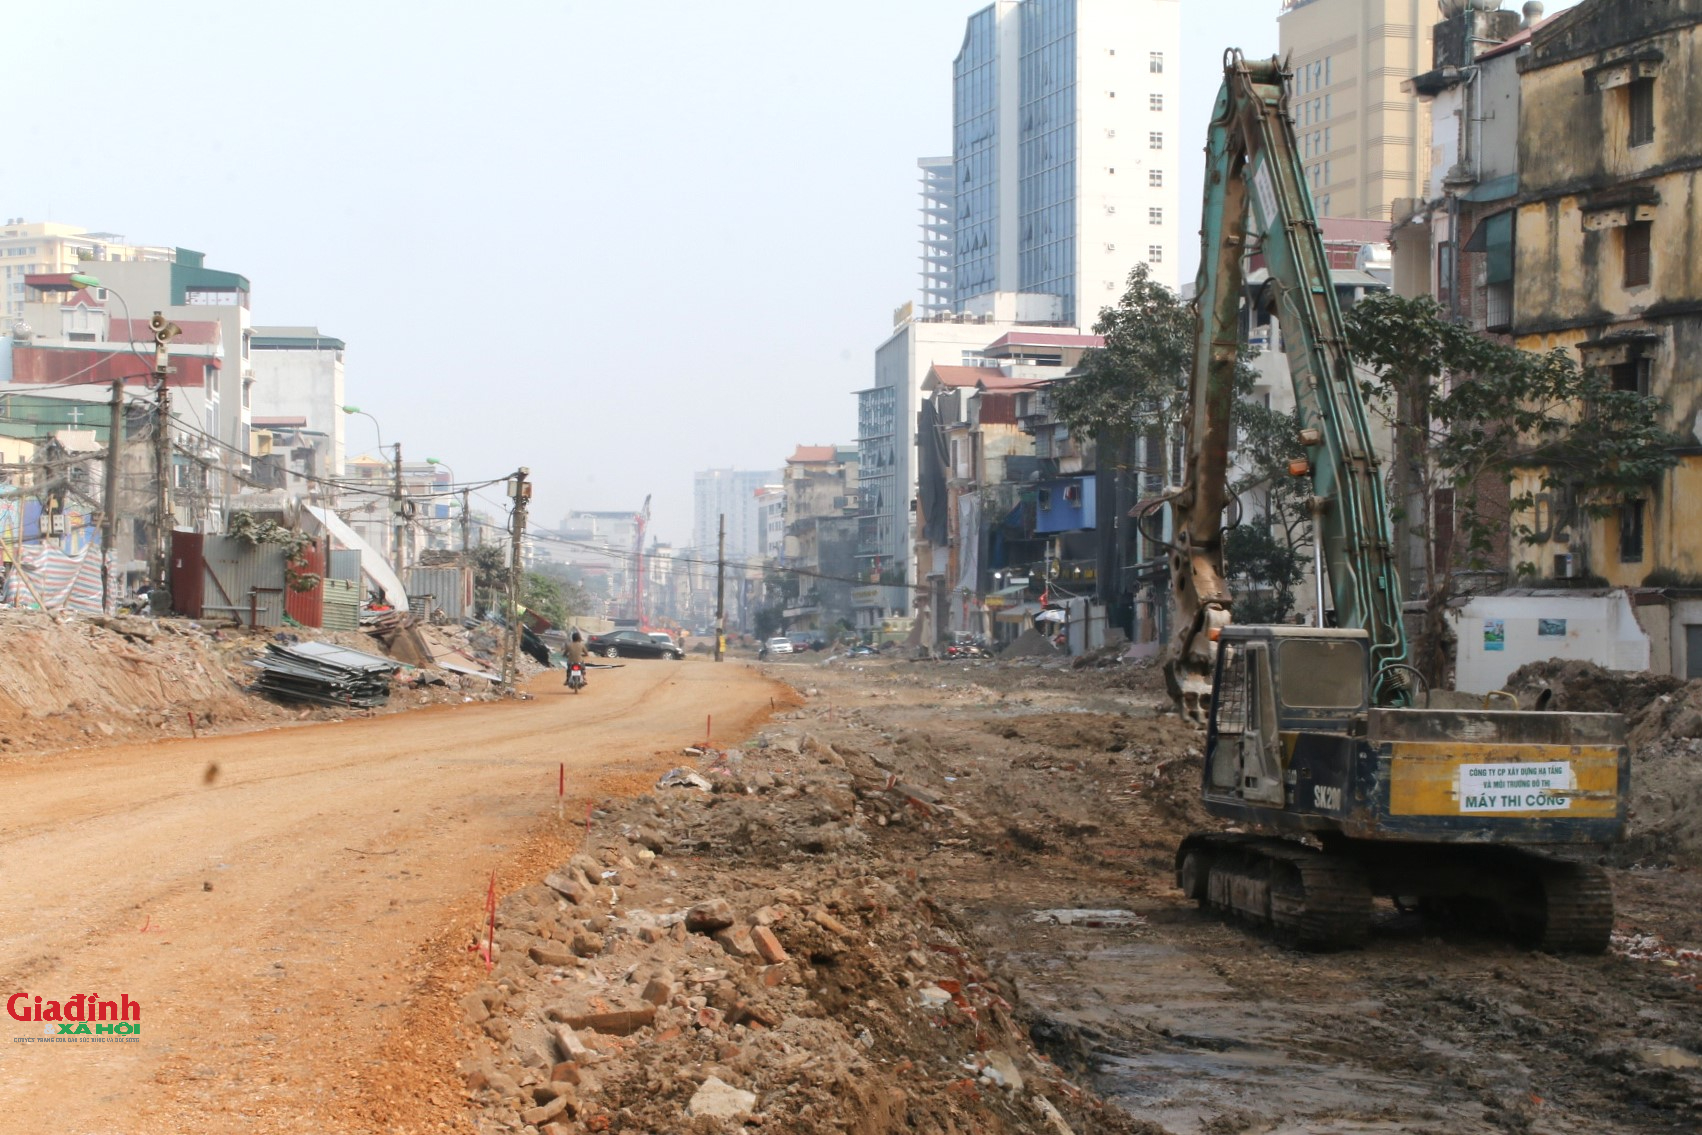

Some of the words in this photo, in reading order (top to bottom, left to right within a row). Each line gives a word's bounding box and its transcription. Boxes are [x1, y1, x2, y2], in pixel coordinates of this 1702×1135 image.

[1469, 768, 1487, 777] CÔNG
[1497, 768, 1506, 777] CP
[1507, 767, 1519, 776] XÂY
[1538, 767, 1547, 777] HẠ
[1483, 780, 1492, 789] VÀ
[1493, 780, 1505, 789] MÔI
[1465, 793, 1497, 808] MÁY
[1501, 795, 1521, 807] THI
[1526, 791, 1565, 807] CÔNG
